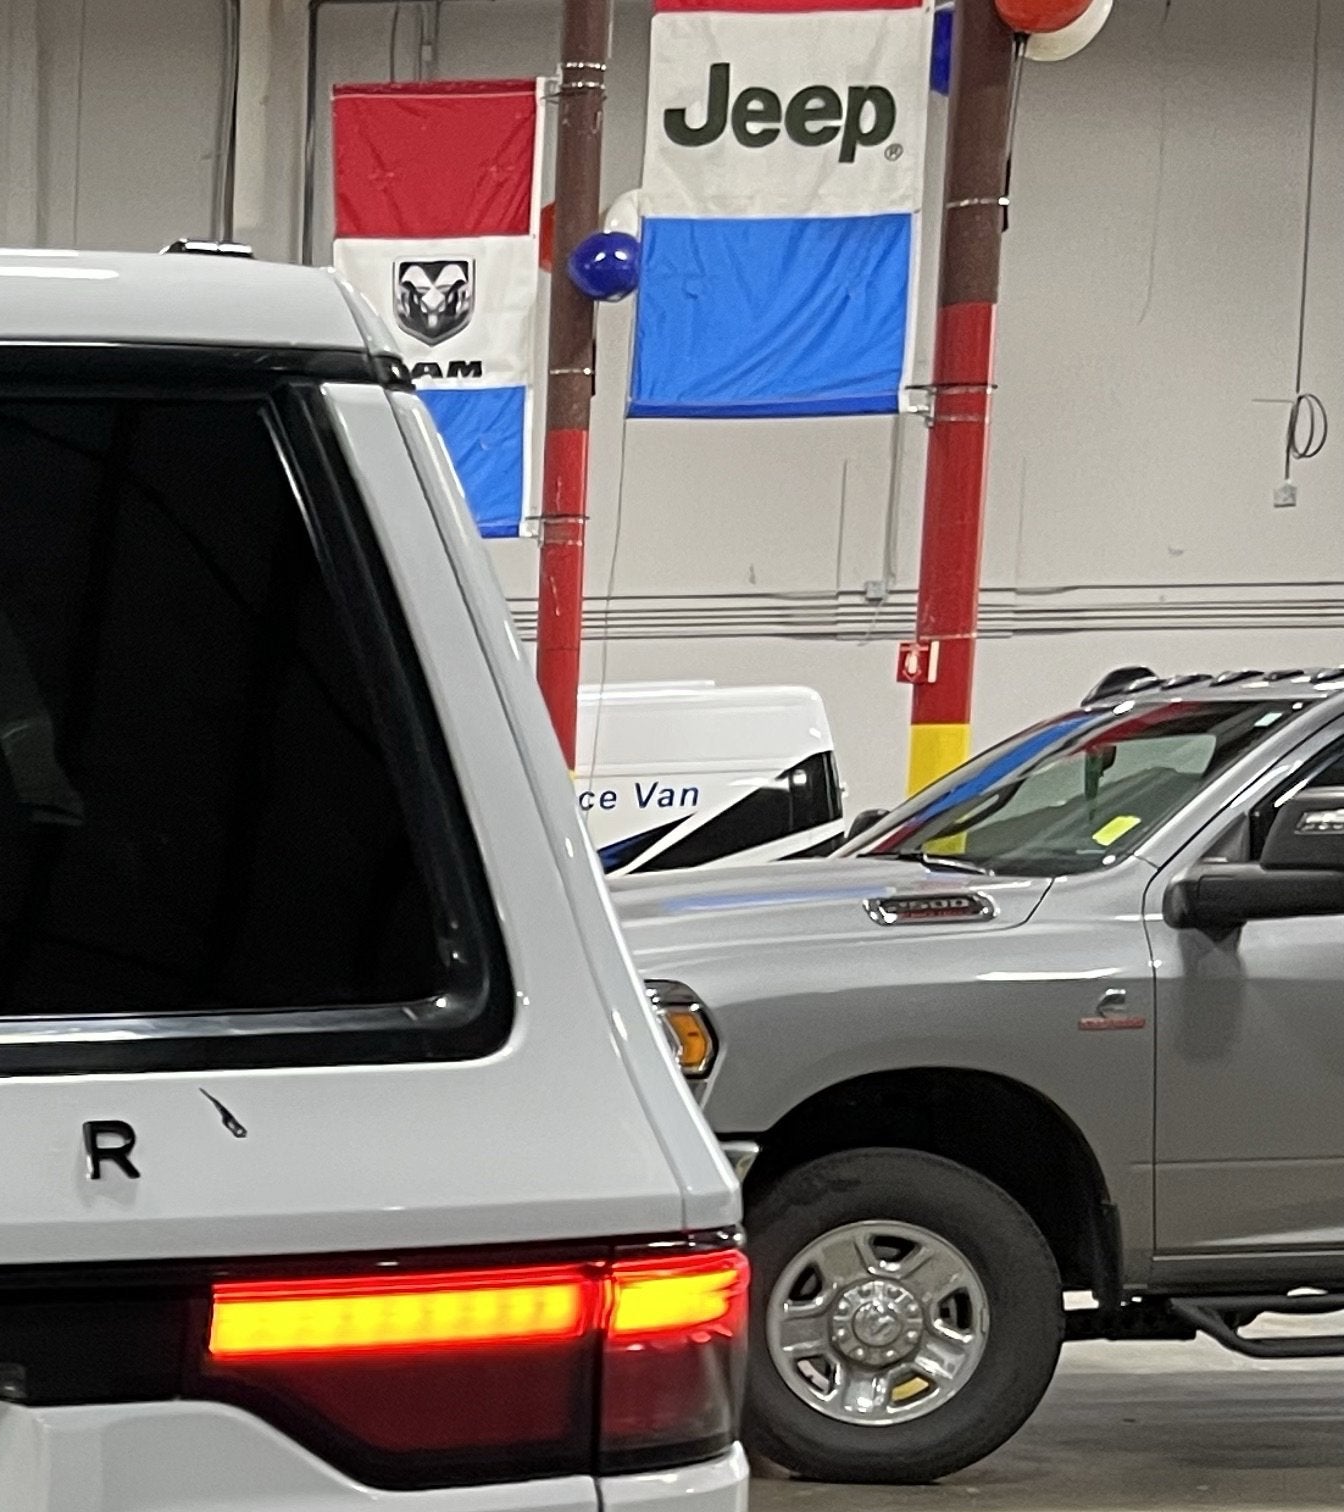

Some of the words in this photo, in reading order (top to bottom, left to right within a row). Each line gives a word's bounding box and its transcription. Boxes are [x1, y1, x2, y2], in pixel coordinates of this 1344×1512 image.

[663, 62, 896, 163] Jeep
[411, 361, 483, 378] AM
[635, 781, 699, 809] Van
